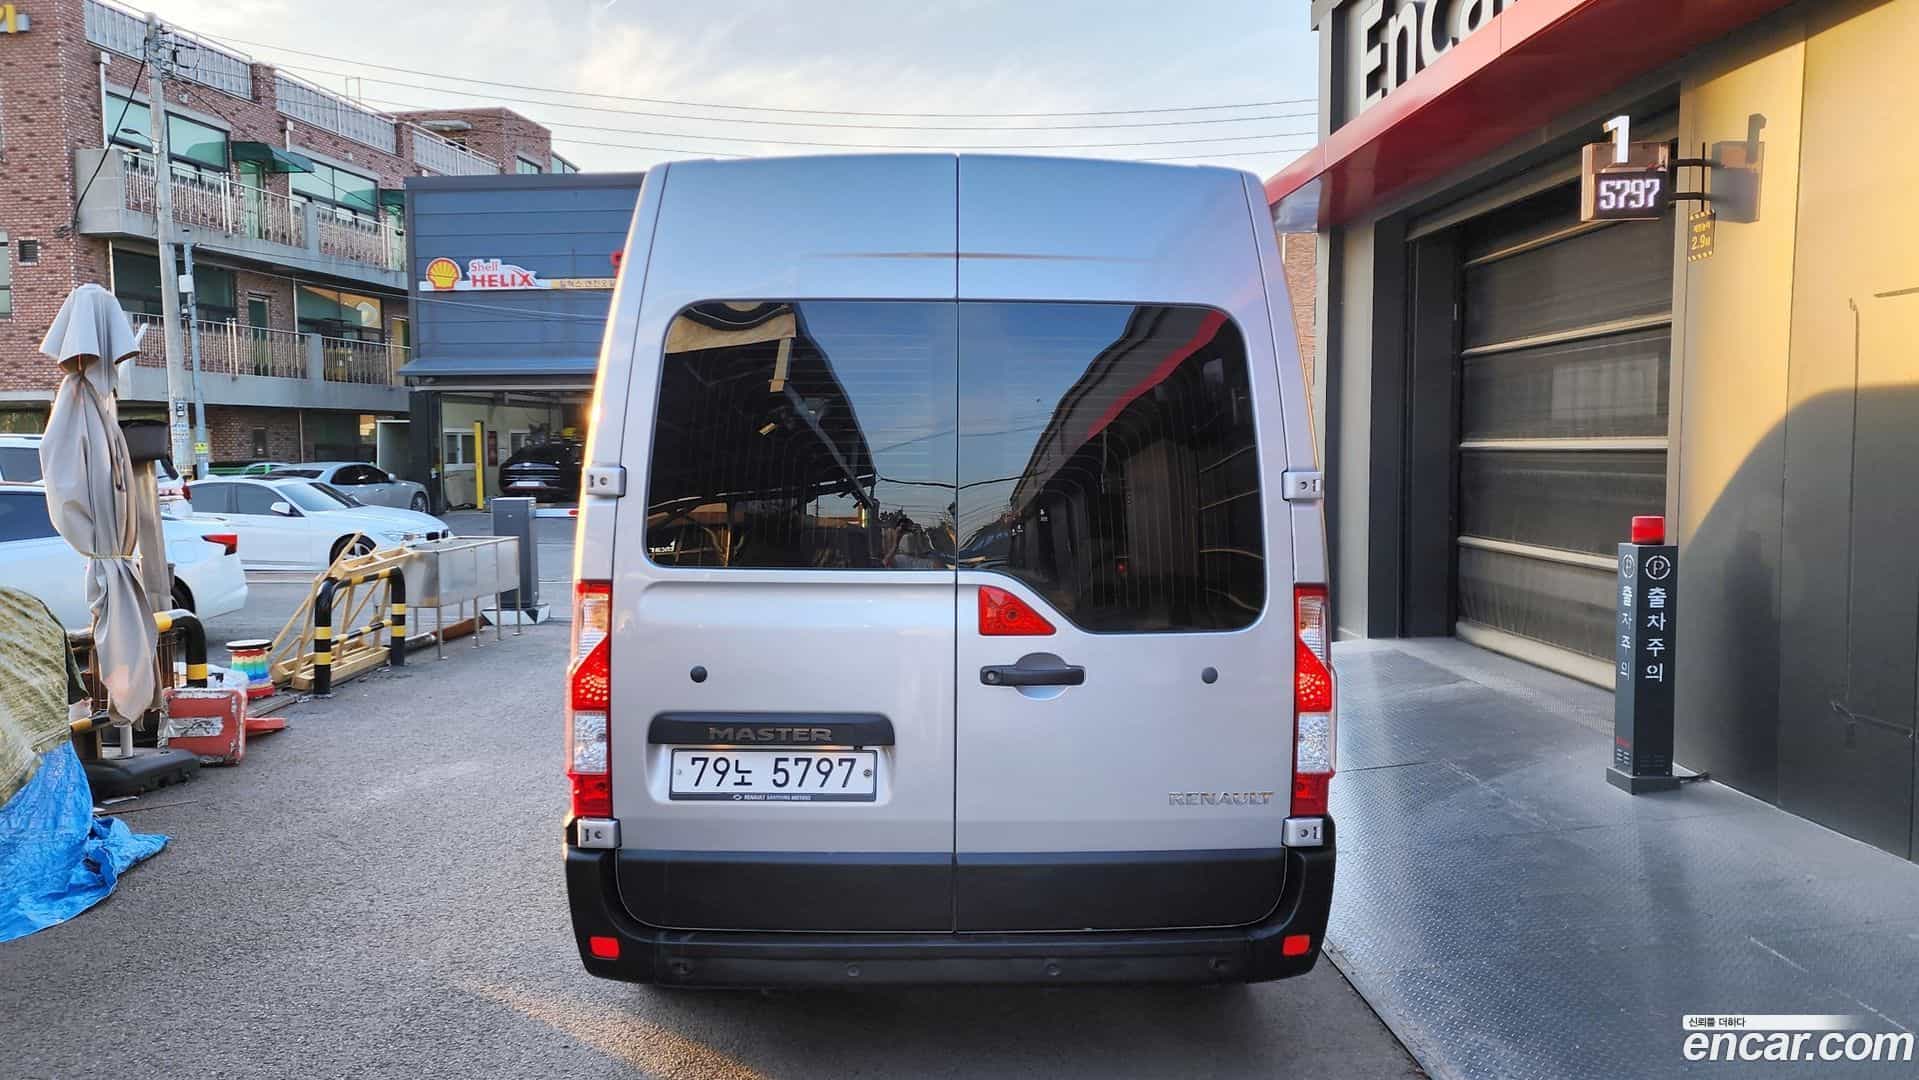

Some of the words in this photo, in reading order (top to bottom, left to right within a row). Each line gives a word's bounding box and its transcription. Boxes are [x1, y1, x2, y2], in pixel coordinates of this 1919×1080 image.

[1604, 115, 1630, 163] 1
[1600, 178, 1661, 209] 5797
[471, 262, 499, 272] Shell
[471, 273, 534, 288] HELIX
[708, 727, 833, 742] MASTER
[691, 757, 753, 787] 79노
[772, 757, 857, 788] 5797
[1168, 791, 1274, 806] RENAULT
